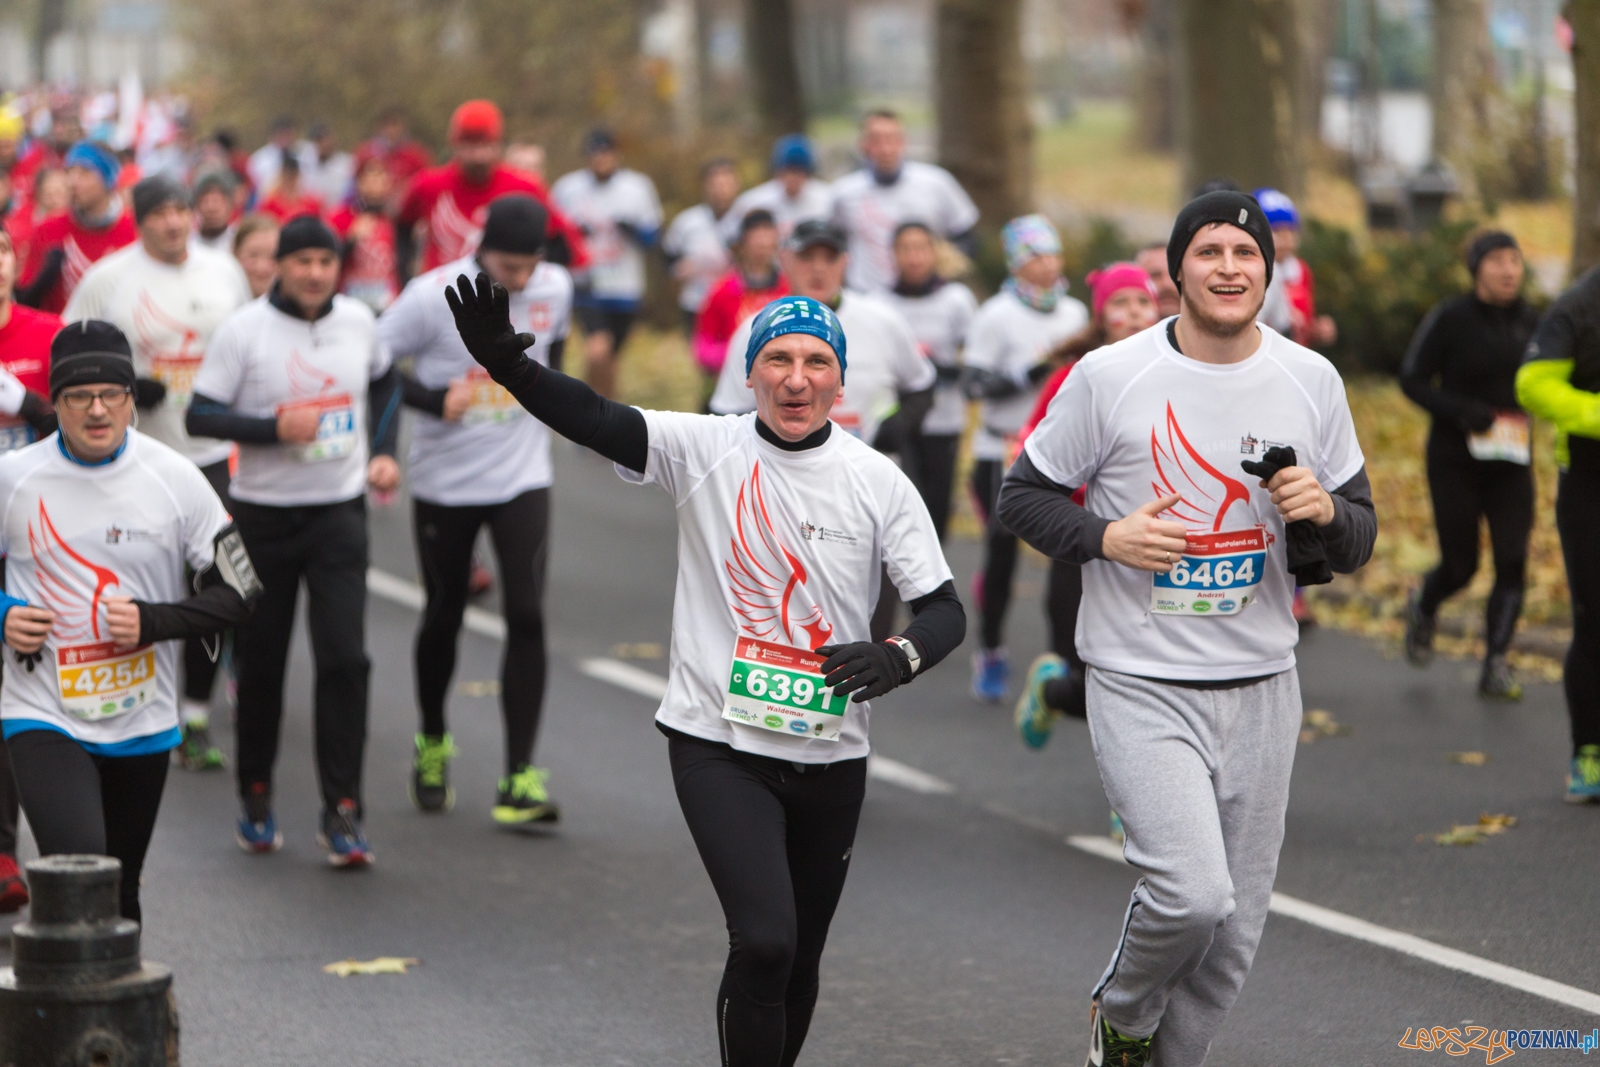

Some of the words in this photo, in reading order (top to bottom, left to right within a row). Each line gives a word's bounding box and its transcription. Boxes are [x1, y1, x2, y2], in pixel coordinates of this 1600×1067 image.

[1215, 539, 1258, 549] RunPoland.org
[1169, 557, 1254, 587] 6464
[74, 656, 148, 693] 4254
[746, 669, 835, 710] 6391
[728, 713, 751, 721] LUXMED
[730, 706, 748, 715] GRUPA
[766, 705, 804, 718] Waldemar
